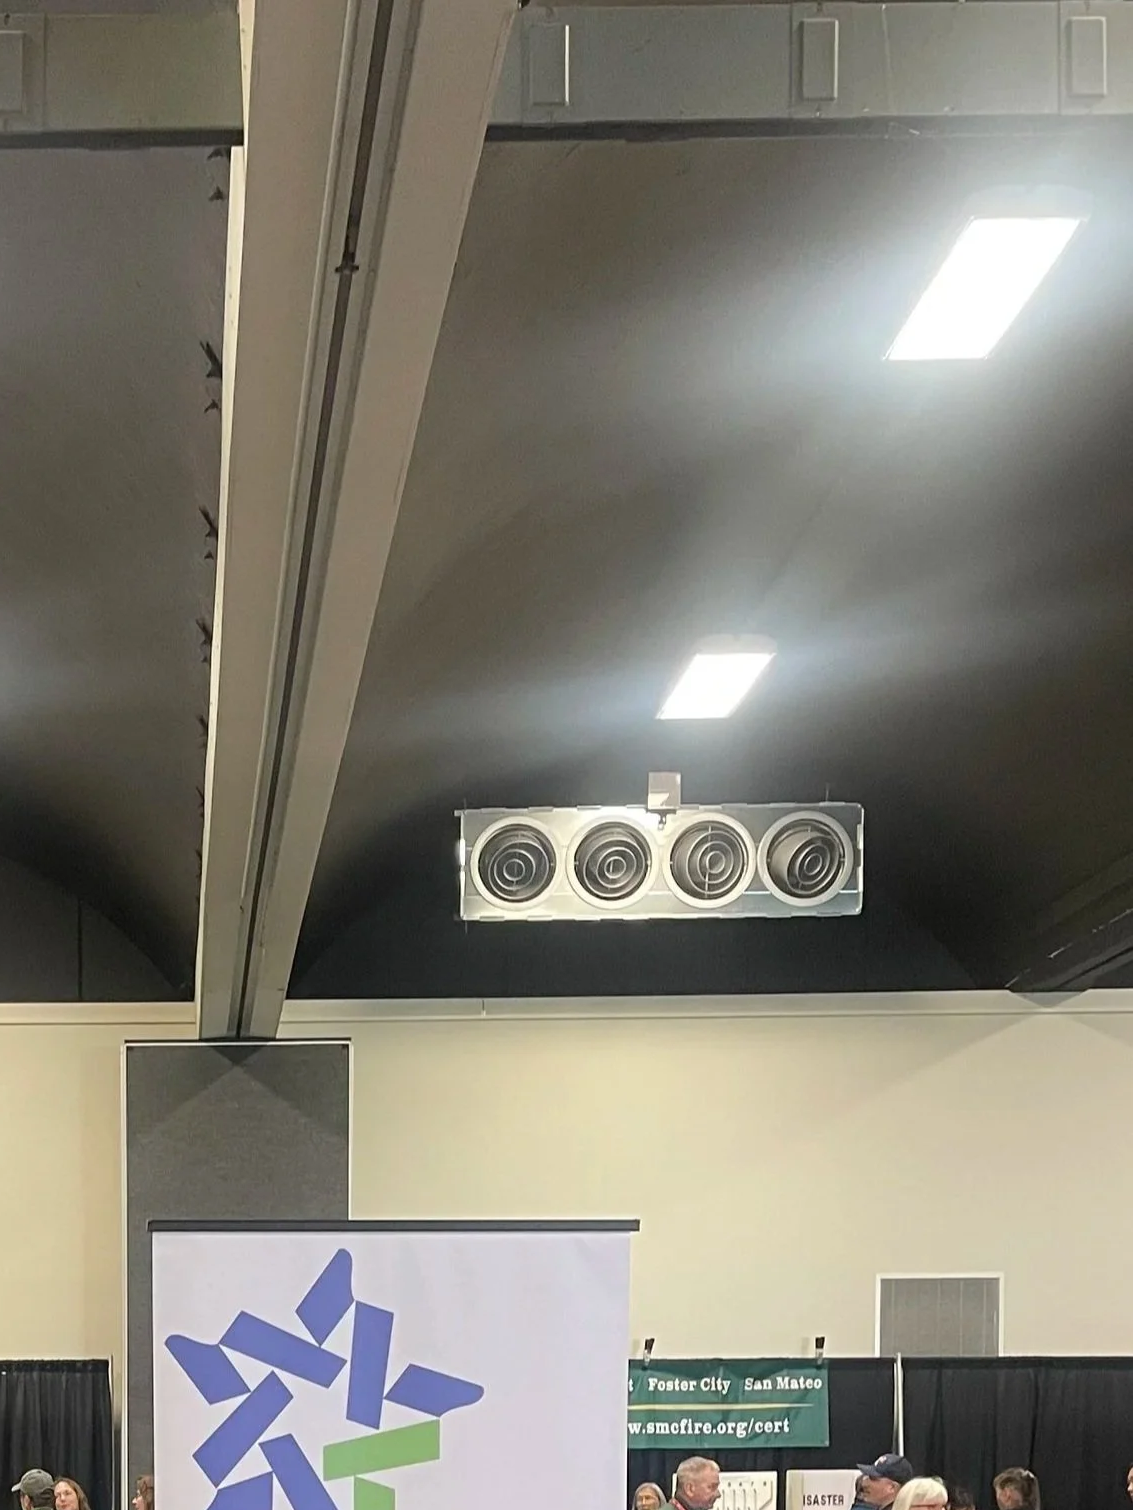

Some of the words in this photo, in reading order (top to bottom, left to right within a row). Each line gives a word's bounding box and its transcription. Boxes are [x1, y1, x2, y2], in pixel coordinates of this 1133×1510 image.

[648, 1378, 697, 1392] Foster
[700, 1377, 731, 1395] City
[744, 1377, 772, 1391] San
[777, 1376, 822, 1390] Mateo
